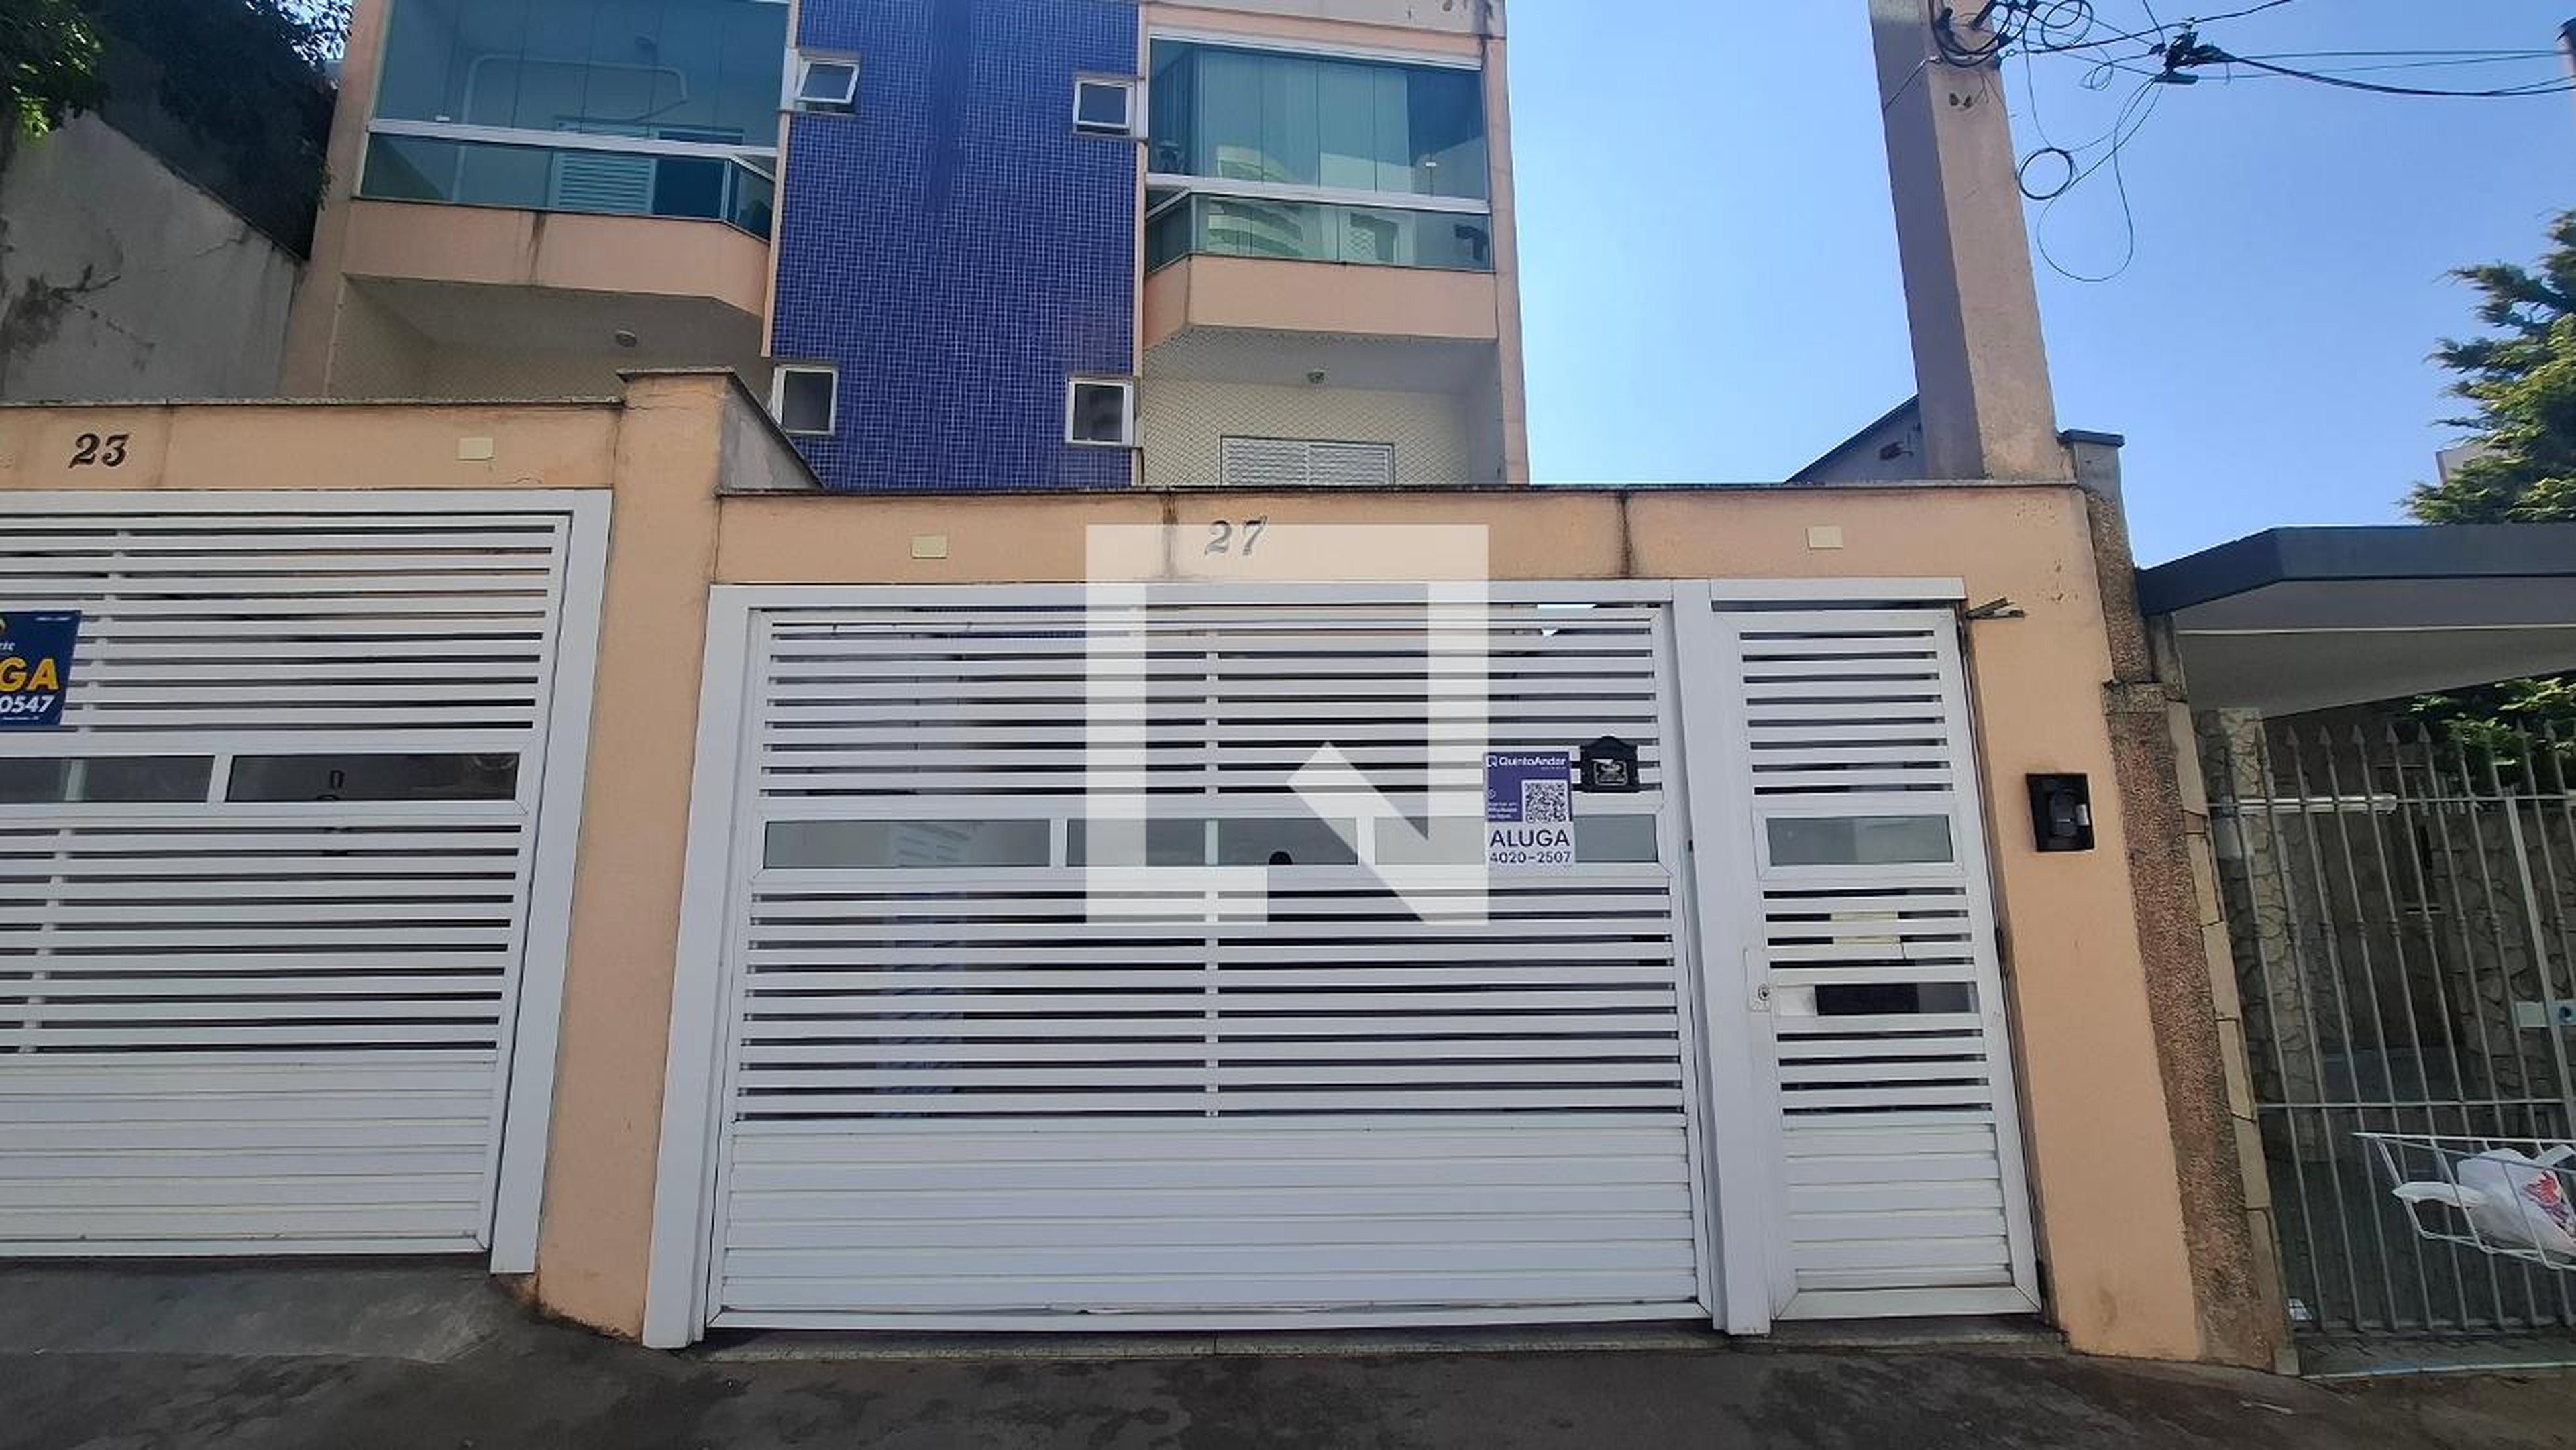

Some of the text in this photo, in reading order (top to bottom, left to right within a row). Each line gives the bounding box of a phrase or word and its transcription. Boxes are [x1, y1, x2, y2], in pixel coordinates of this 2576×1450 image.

[68, 433, 129, 469] 23
[1204, 515, 1268, 556] 27
[1490, 829, 1570, 846] ALUGA
[1490, 851, 1571, 863] 4020-2507
